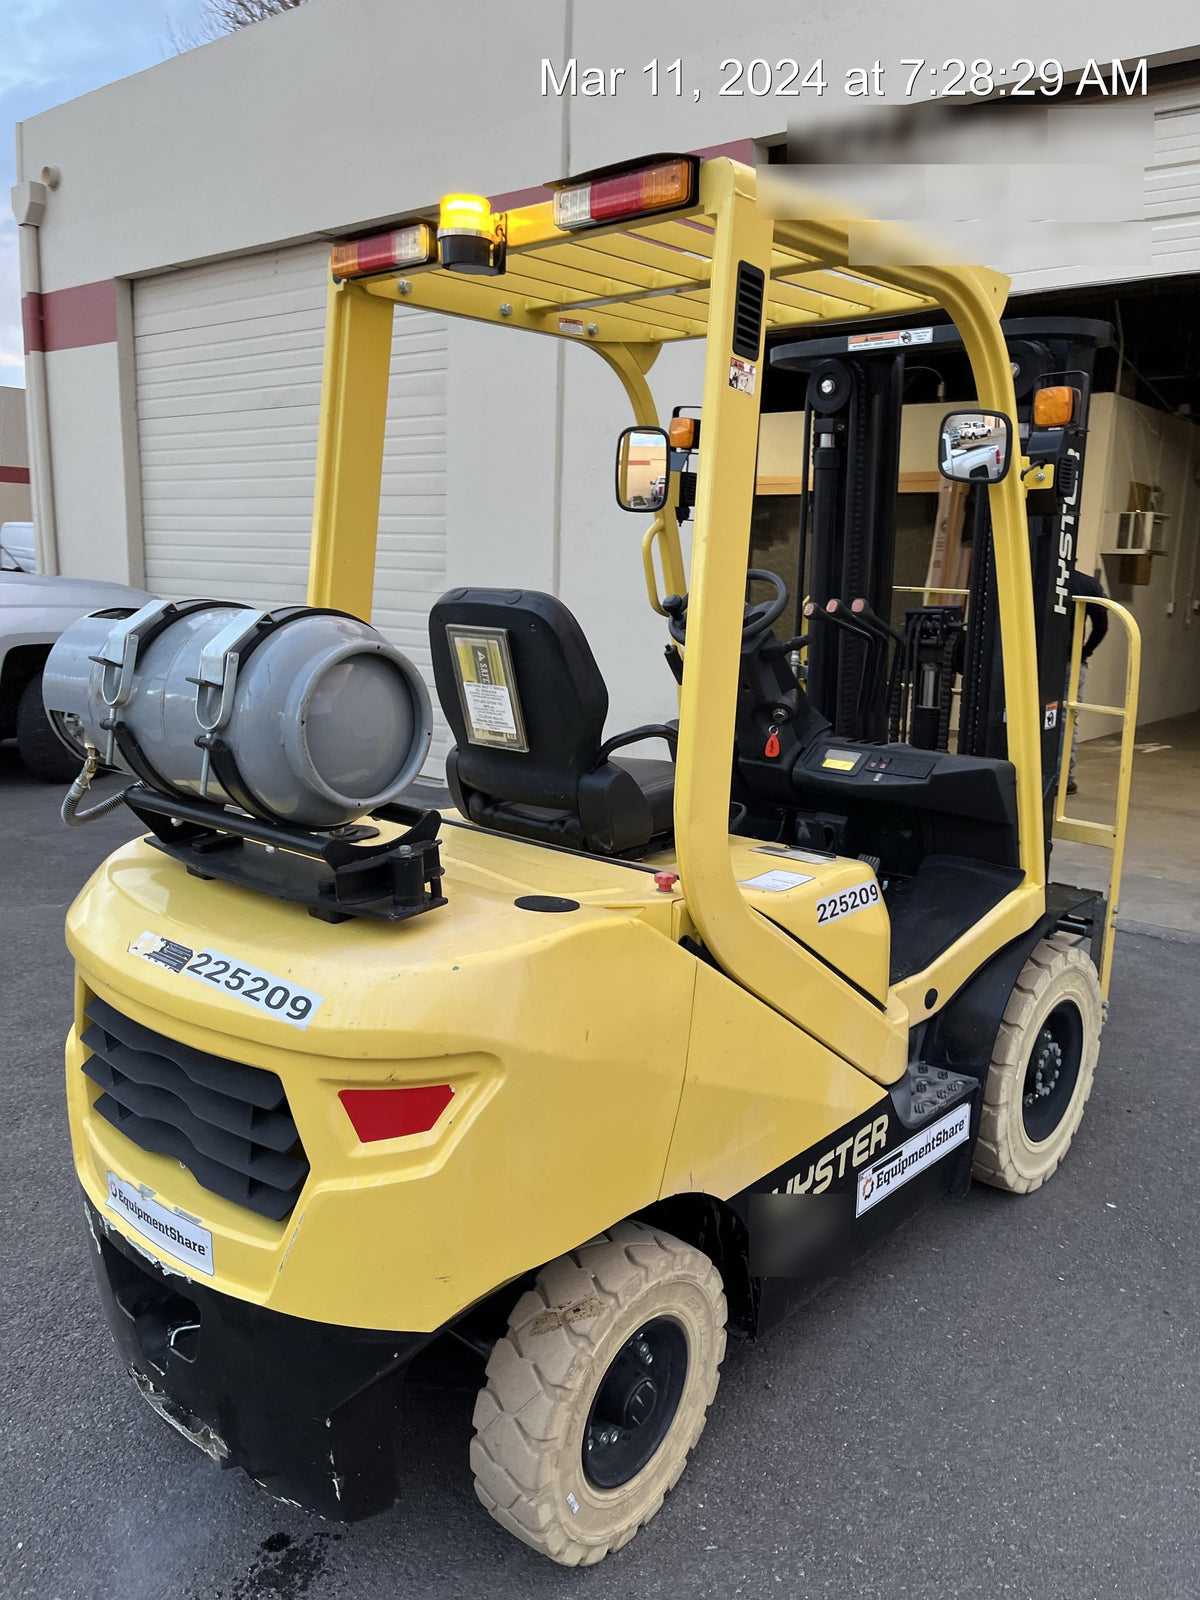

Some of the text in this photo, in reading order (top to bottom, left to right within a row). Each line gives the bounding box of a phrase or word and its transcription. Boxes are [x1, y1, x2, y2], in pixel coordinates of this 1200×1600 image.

[1054, 448, 1081, 616] HYST
[817, 883, 879, 924] 225209
[187, 952, 313, 1021] 225209
[771, 1113, 889, 1195] YSTER
[875, 1118, 965, 1190] EquipmentShare
[117, 1188, 207, 1256] EquipmentShare
